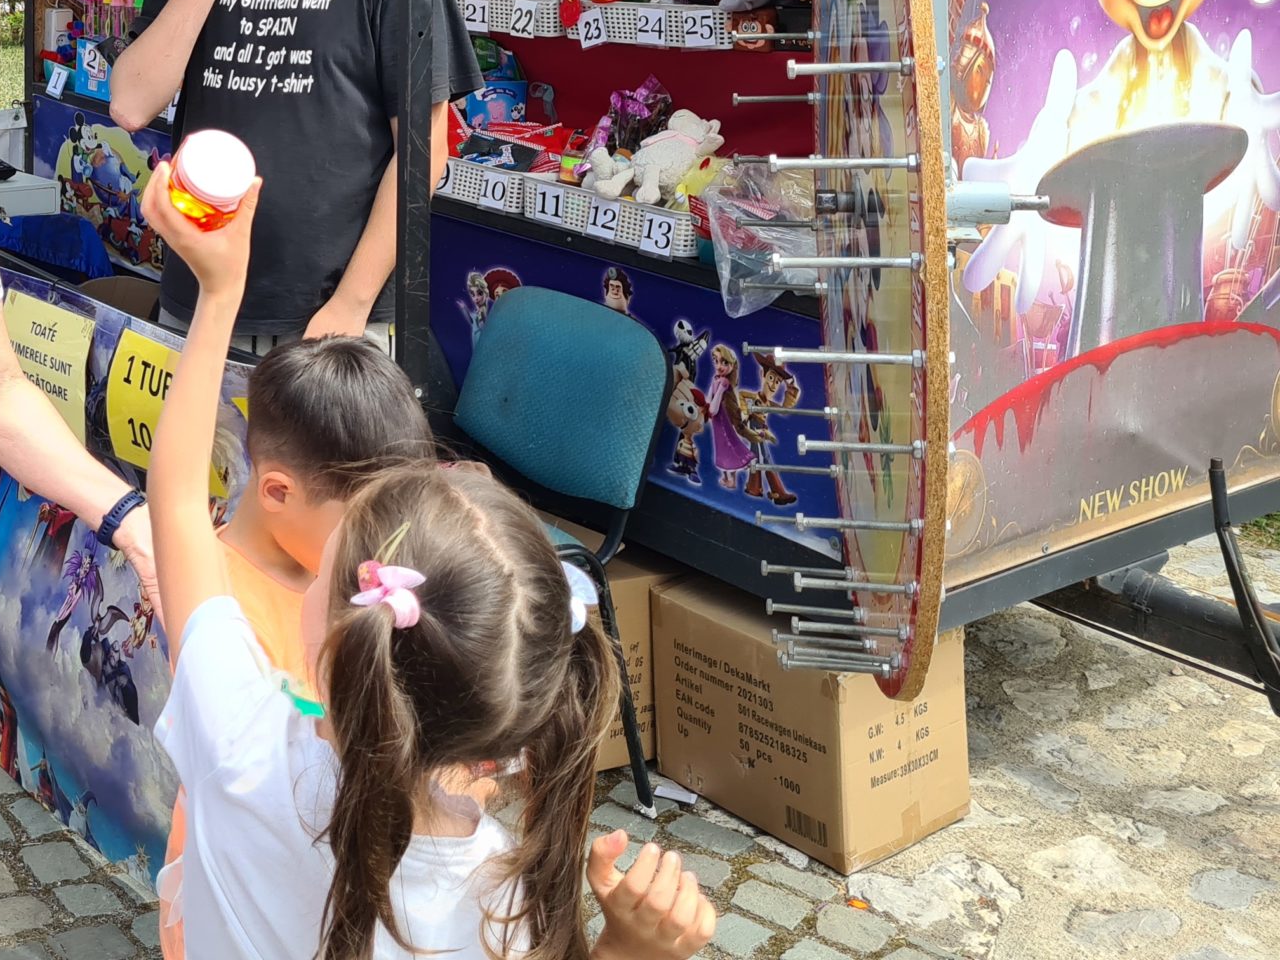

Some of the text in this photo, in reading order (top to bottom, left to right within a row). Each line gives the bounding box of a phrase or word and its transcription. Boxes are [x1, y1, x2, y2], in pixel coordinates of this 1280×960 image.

[240, 16, 298, 36] to SPAIN
[466, 3, 488, 24] 21
[511, 7, 532, 34] 22
[584, 18, 602, 42] 23
[638, 15, 664, 40] 24
[684, 15, 714, 40] 25
[86, 49, 97, 70] 2
[214, 42, 312, 70] and all I got was
[51, 71, 62, 90] 1
[202, 67, 314, 97] this lousy t-shirt
[481, 178, 506, 202] 10
[539, 192, 563, 218] 11
[591, 204, 617, 231] 12
[643, 217, 671, 249] 13
[9, 339, 73, 377] UMERELE SUNT
[123, 355, 135, 385] 1
[22, 369, 69, 402] TIGĂTOARE
[127, 417, 152, 452] 10
[1078, 464, 1189, 524] NEW SHOW
[674, 656, 774, 712] Order nummer 2021303
[675, 673, 703, 694] Artikel
[724, 662, 771, 693] DekaMarkt
[675, 689, 694, 707] EAN
[695, 700, 715, 718] code
[895, 712, 905, 726] 4.5
[913, 702, 928, 718] KGS
[676, 707, 712, 734] Quantity
[739, 738, 750, 752] 50
[756, 749, 773, 763] pcs
[897, 739, 902, 750] 4
[915, 726, 930, 742] KGS
[779, 776, 800, 794] 1000
